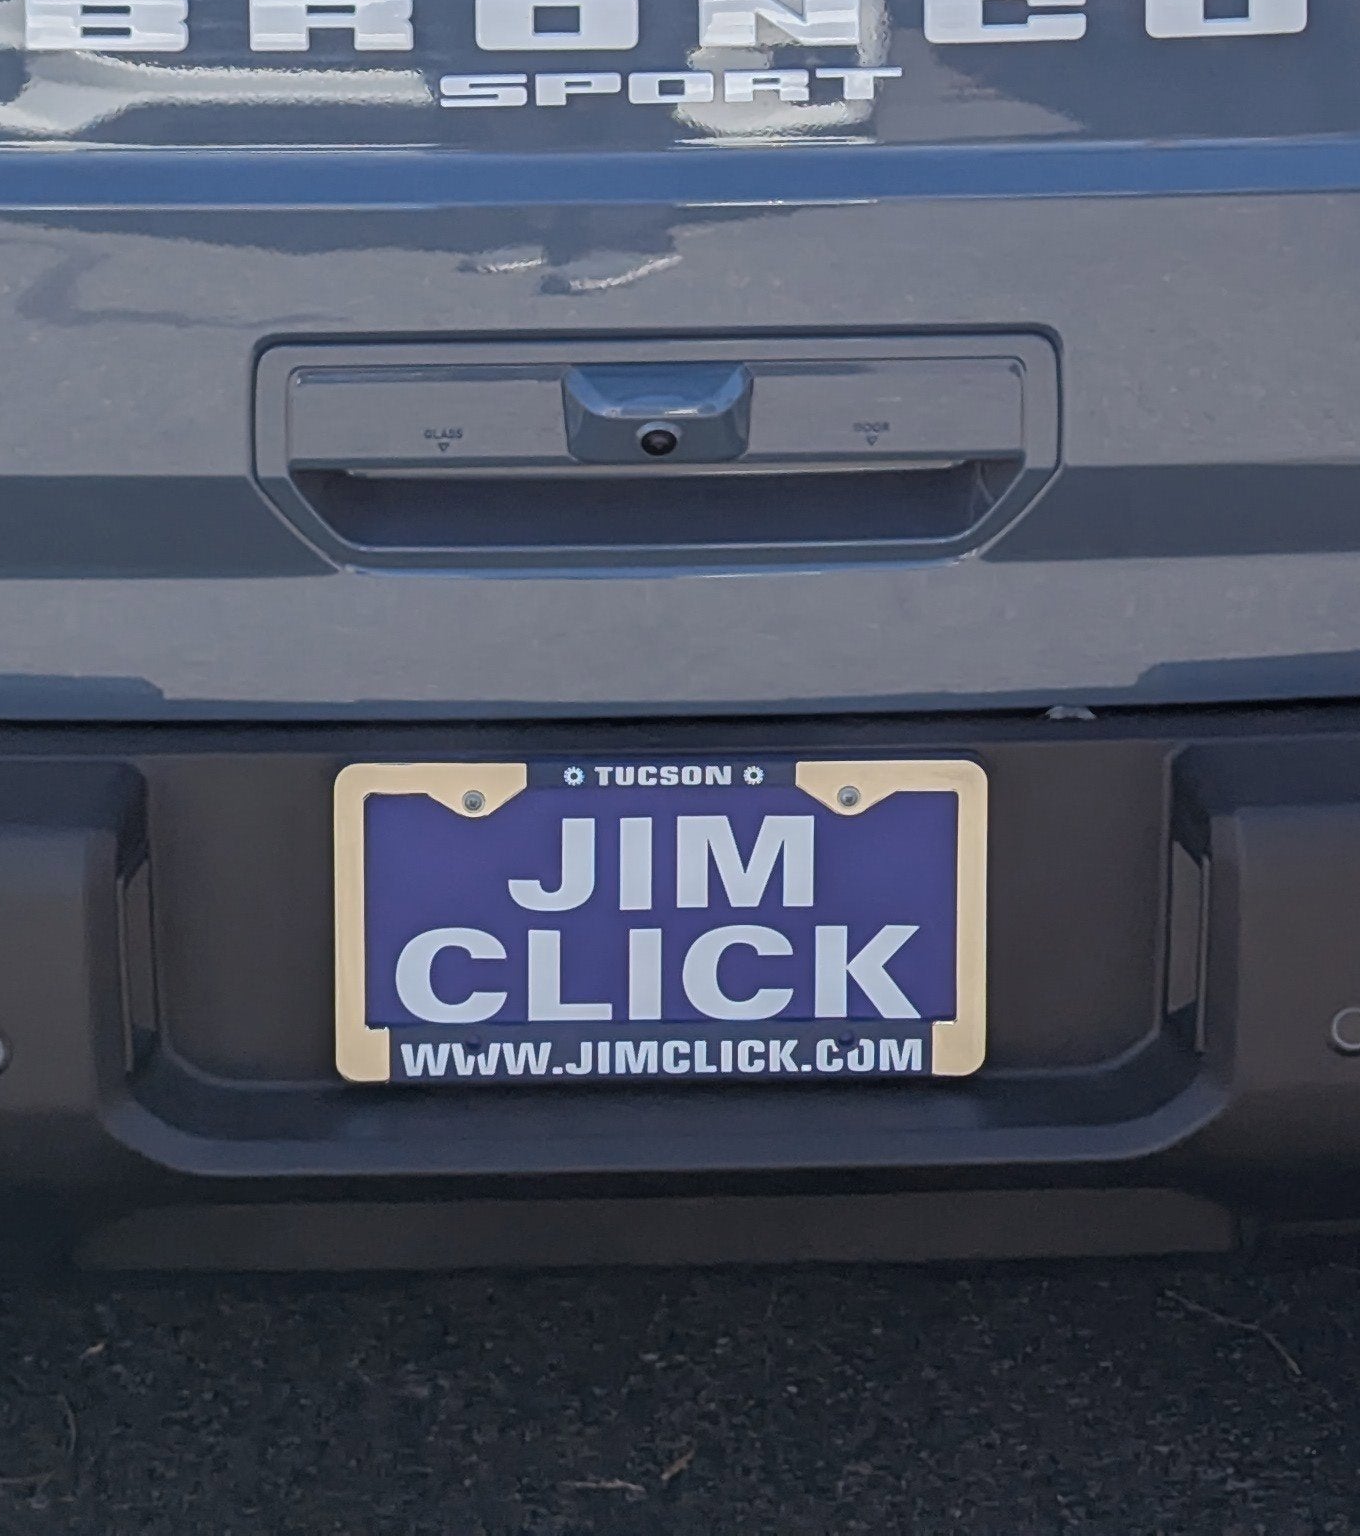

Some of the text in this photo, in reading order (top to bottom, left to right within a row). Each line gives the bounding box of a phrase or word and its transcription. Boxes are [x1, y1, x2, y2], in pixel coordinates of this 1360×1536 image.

[440, 67, 902, 108] SPORT
[594, 765, 733, 786] TUCSON
[507, 814, 816, 911] JIM
[394, 924, 922, 1024] CLICK
[400, 1037, 923, 1077] WWW.JIMCLICK.COM
